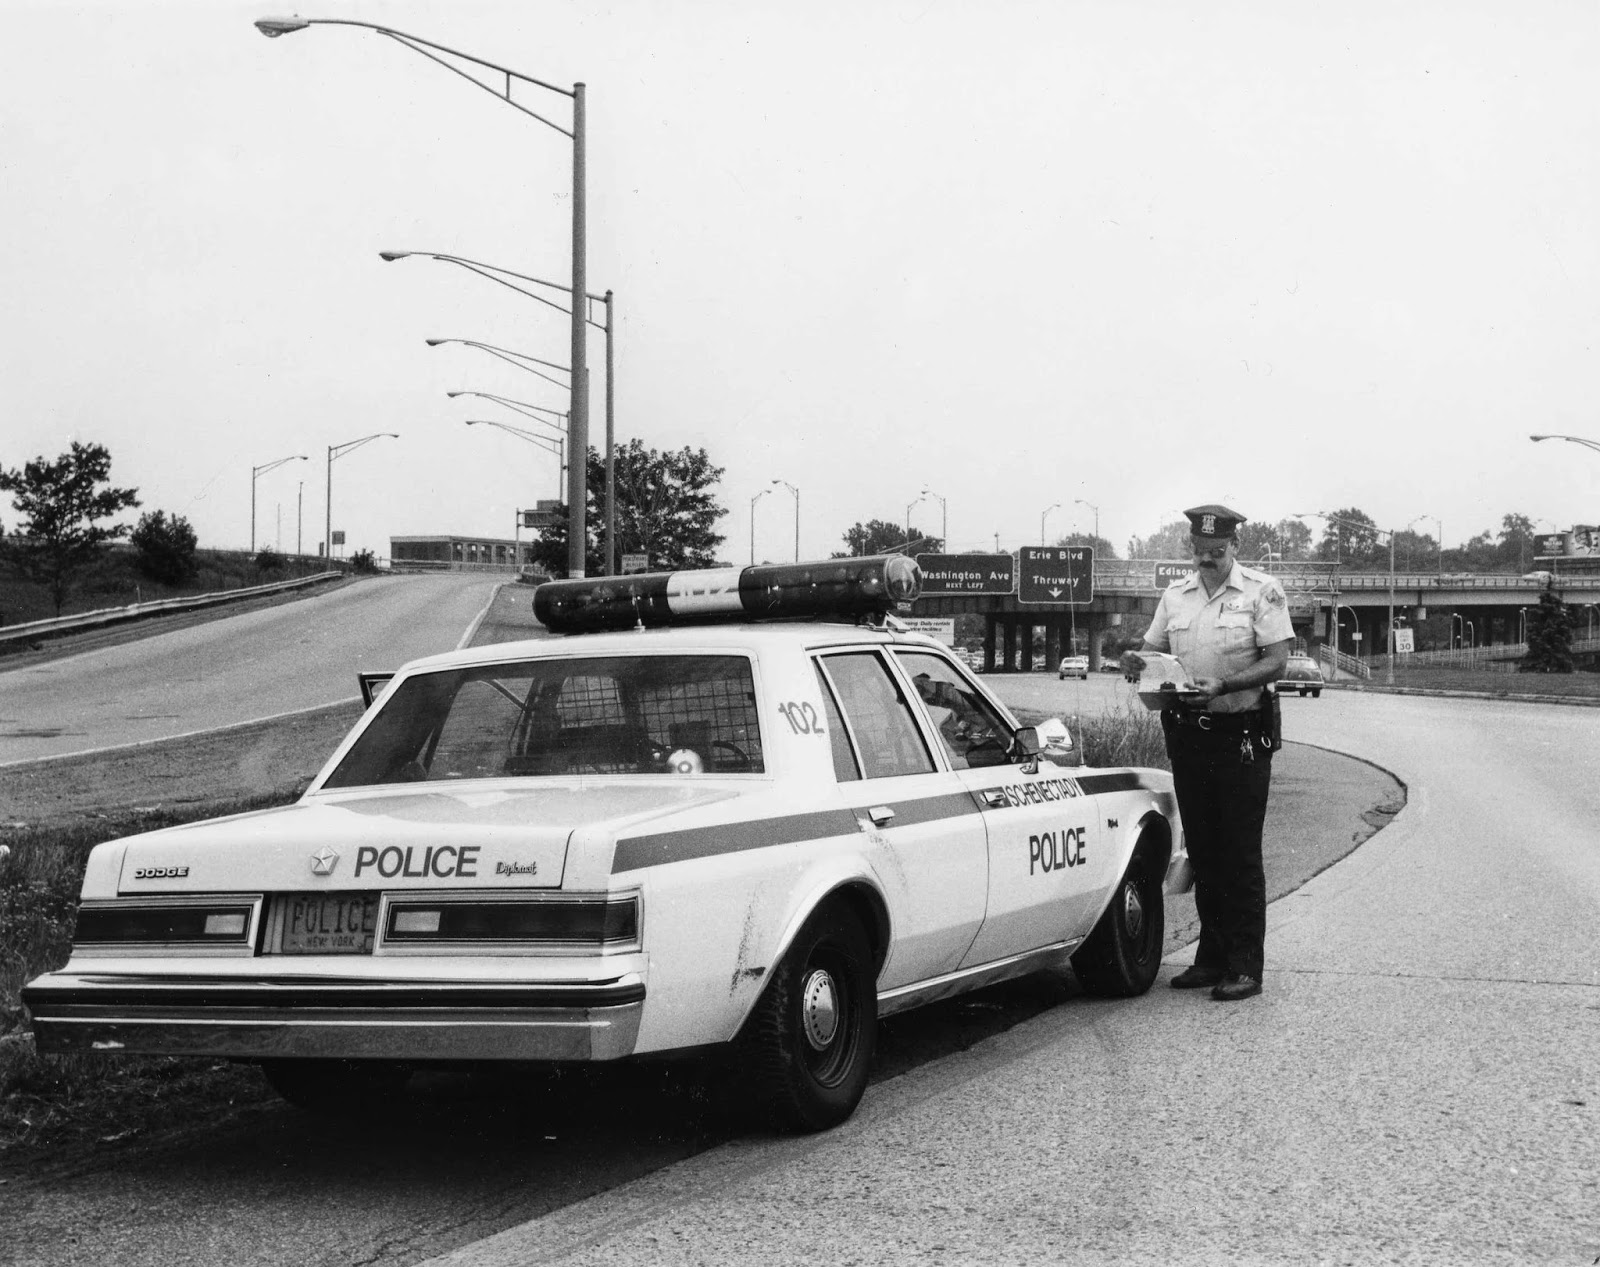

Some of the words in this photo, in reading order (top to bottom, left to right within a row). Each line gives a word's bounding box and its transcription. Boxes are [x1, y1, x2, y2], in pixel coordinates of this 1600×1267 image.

[1029, 550, 1051, 560] Erie
[1059, 551, 1083, 560] Blvd
[921, 570, 982, 583] Washington
[990, 571, 1010, 580] Ave
[1033, 575, 1079, 587] Thruway
[1159, 566, 1194, 576] Edison
[778, 701, 824, 735] 102
[1005, 777, 1082, 807] SCHENECTADY
[1029, 826, 1087, 876] POLICE
[354, 846, 481, 878] POLICE
[135, 867, 189, 879] DODGE
[292, 901, 376, 933] POLICE
